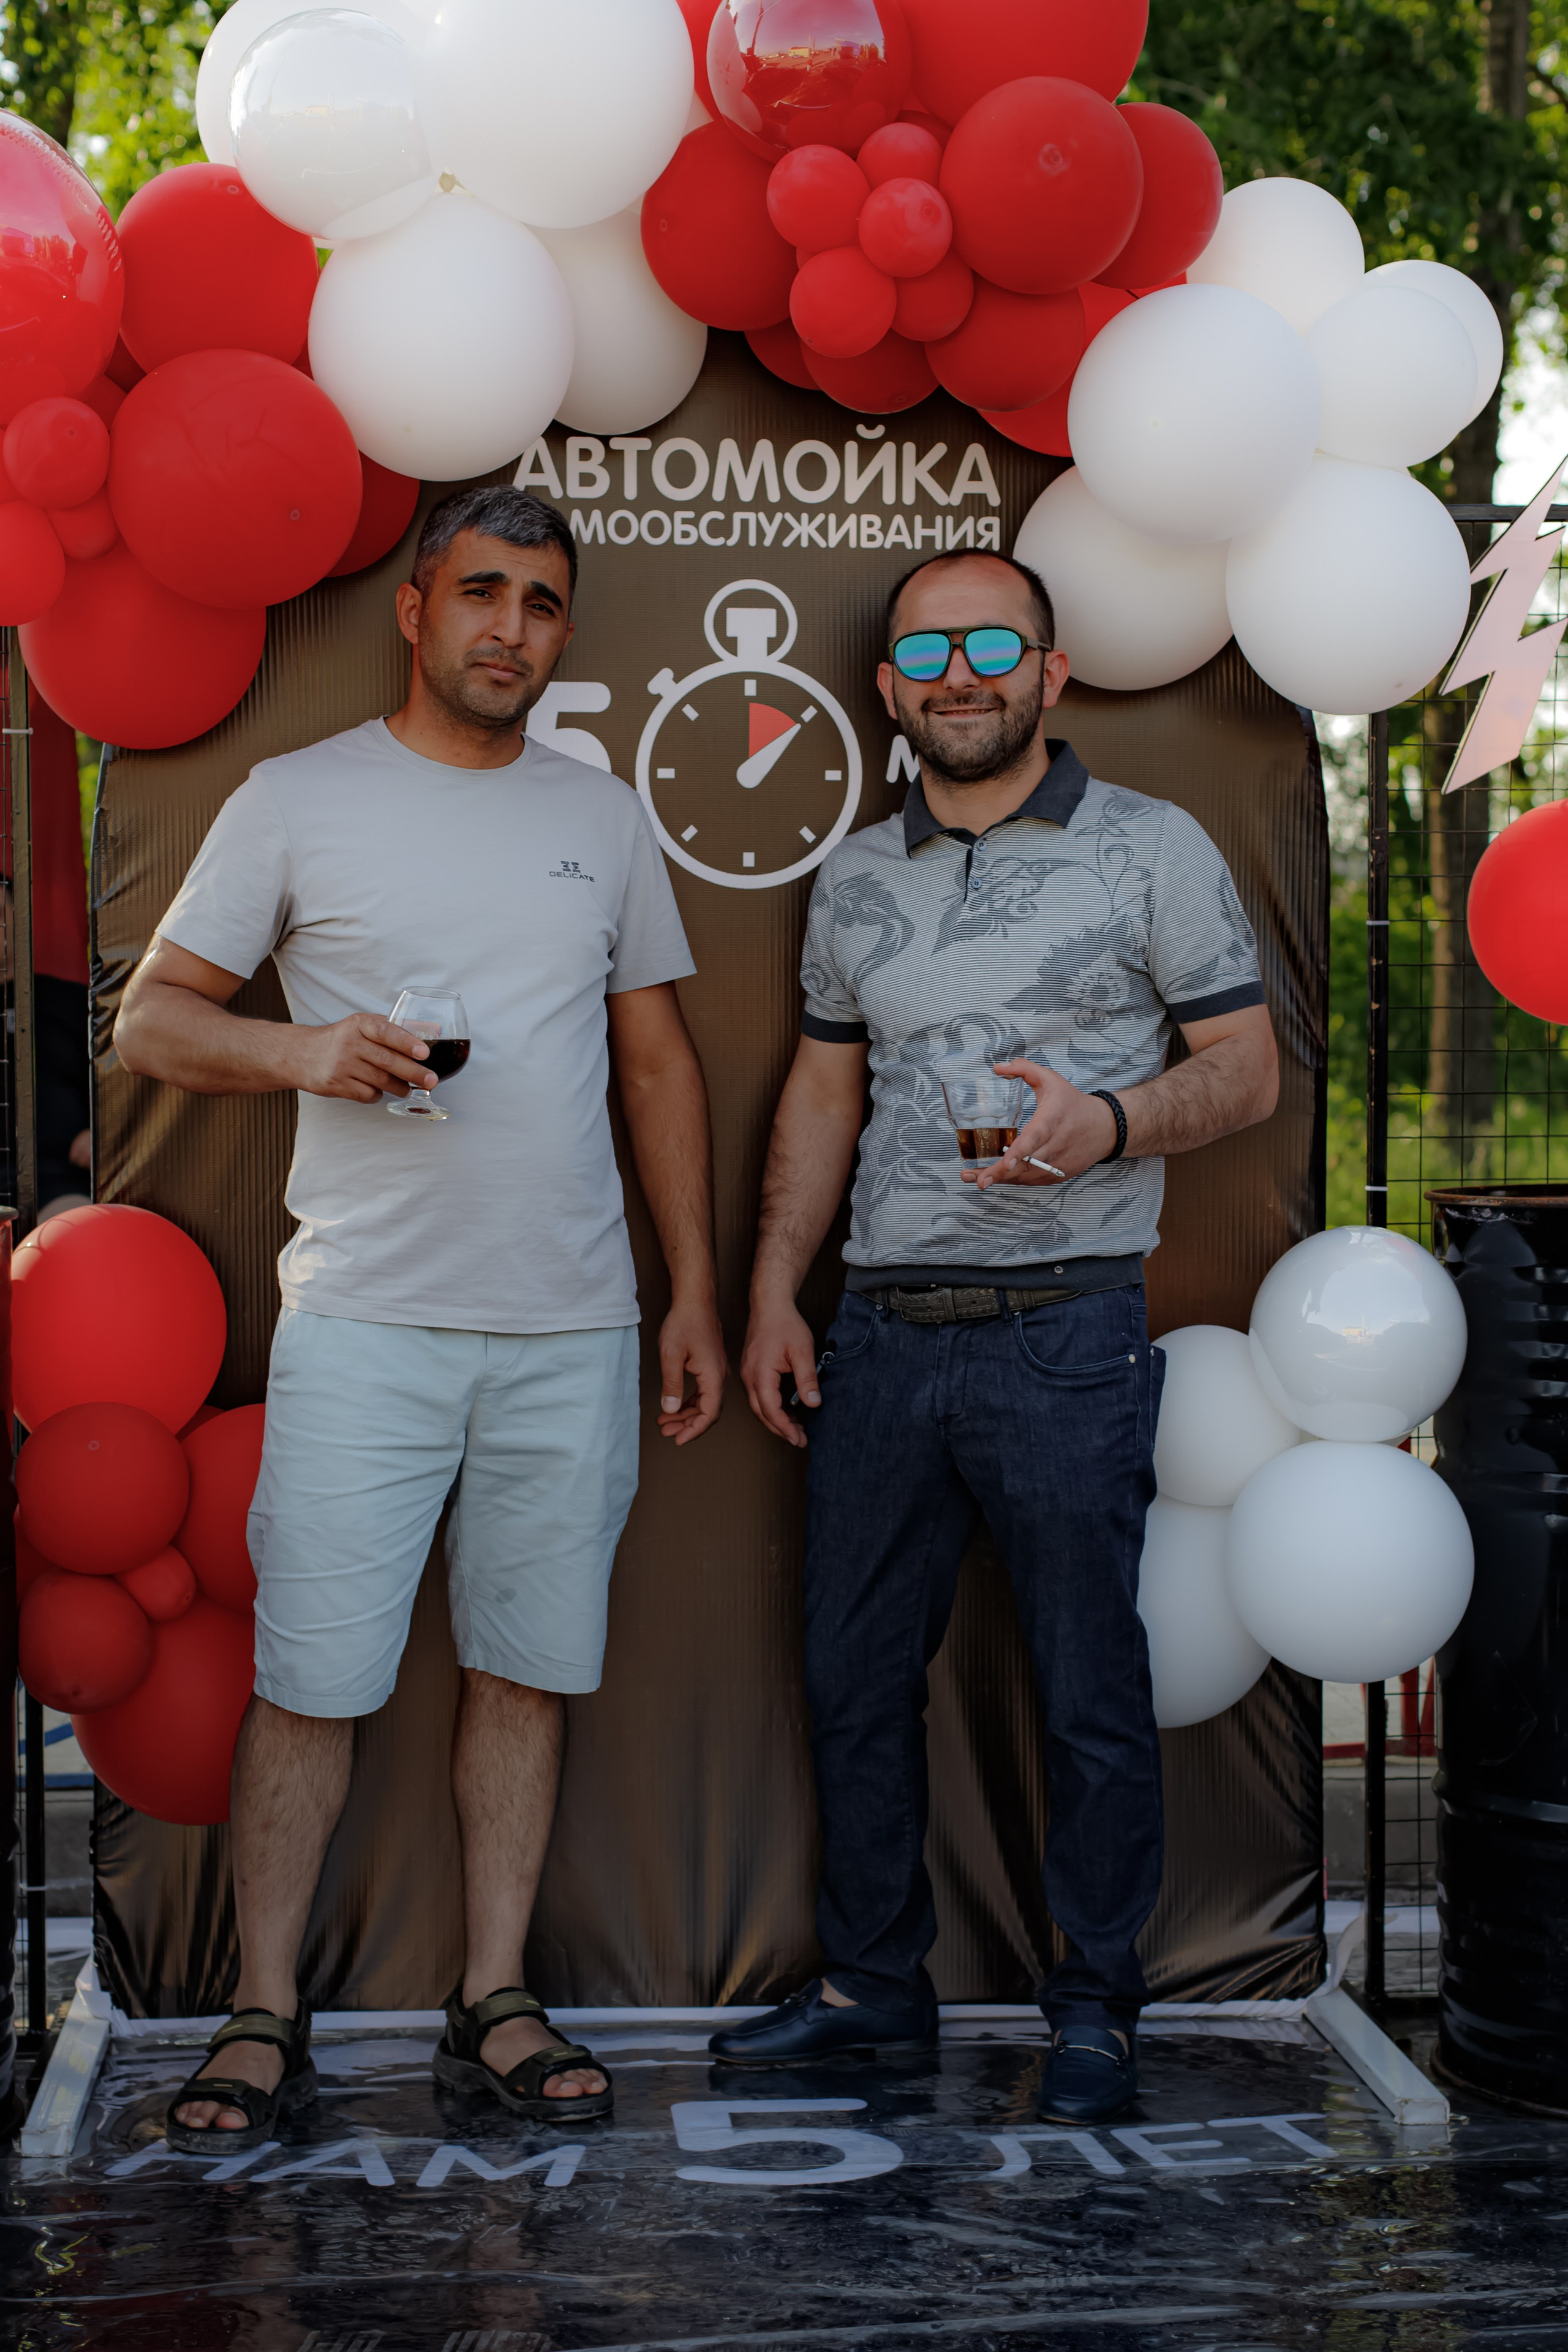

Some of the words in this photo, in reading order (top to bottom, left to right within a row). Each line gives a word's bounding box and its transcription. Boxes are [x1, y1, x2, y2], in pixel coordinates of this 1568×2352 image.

[512, 424, 1001, 507] АВТОМОЙКА
[569, 508, 1001, 551] МООБСЛУЖИВАНИЯ
[549, 871, 595, 883] DELICATE
[671, 2098, 904, 2185] 5
[986, 2113, 1339, 2177] ЛЕТ
